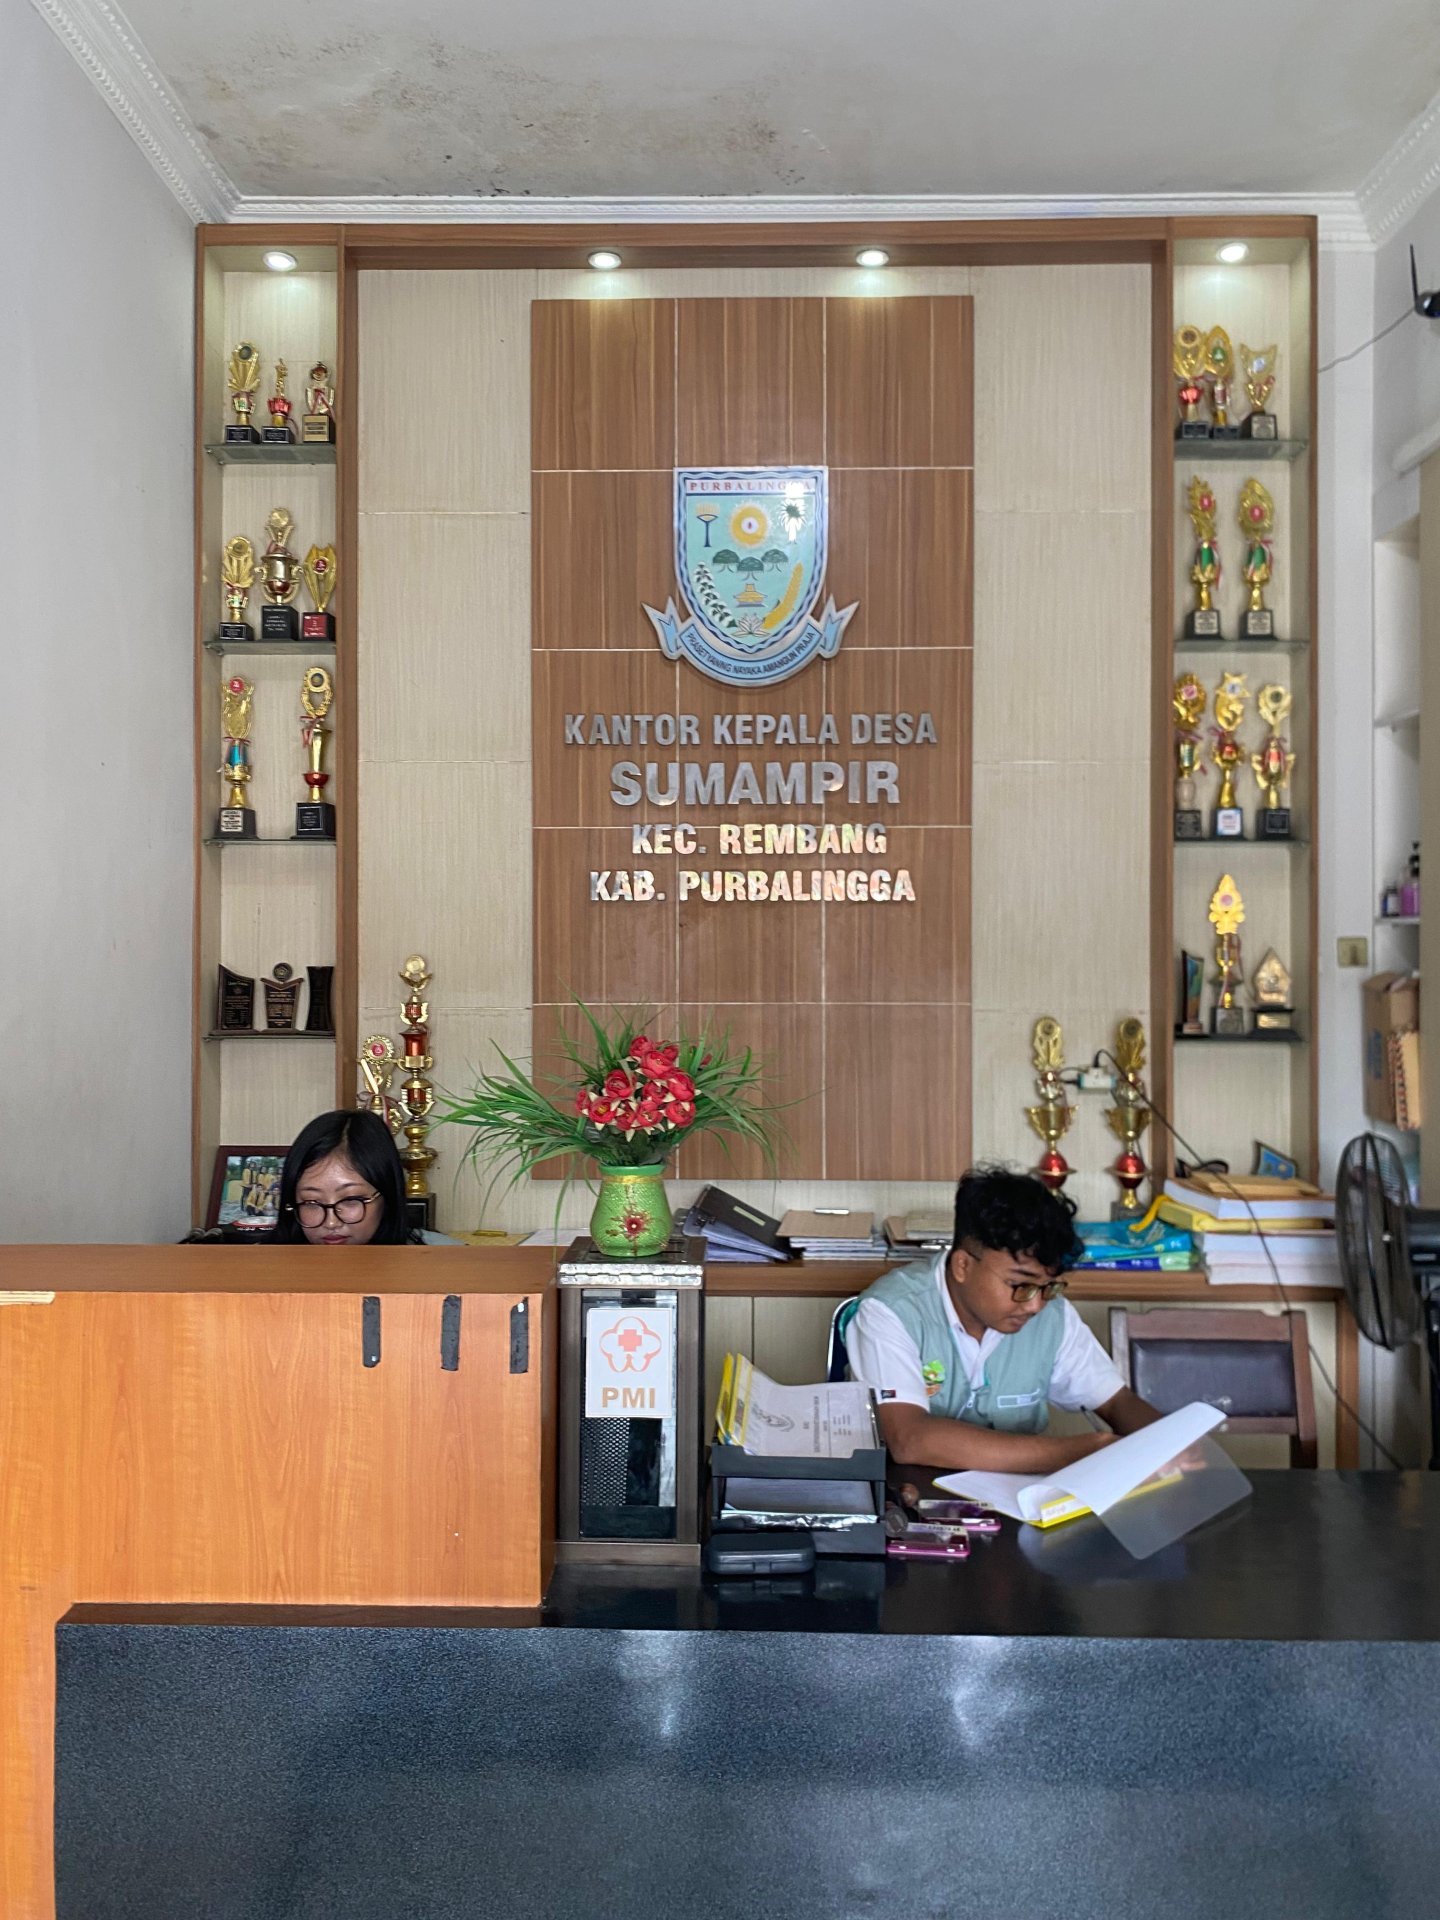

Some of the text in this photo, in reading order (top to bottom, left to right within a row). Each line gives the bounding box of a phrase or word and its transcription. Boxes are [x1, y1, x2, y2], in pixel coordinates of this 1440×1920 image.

[690, 482, 811, 491] PURBALINGA
[795, 632, 815, 655] PRAJA
[565, 713, 938, 746] KANTOR KEPALA DESA
[610, 761, 900, 806] SUMAMPIR
[632, 823, 887, 855] KEC. REMBANG
[590, 869, 916, 901] KAB. PURBALINGGA
[601, 1386, 656, 1409] PMI
